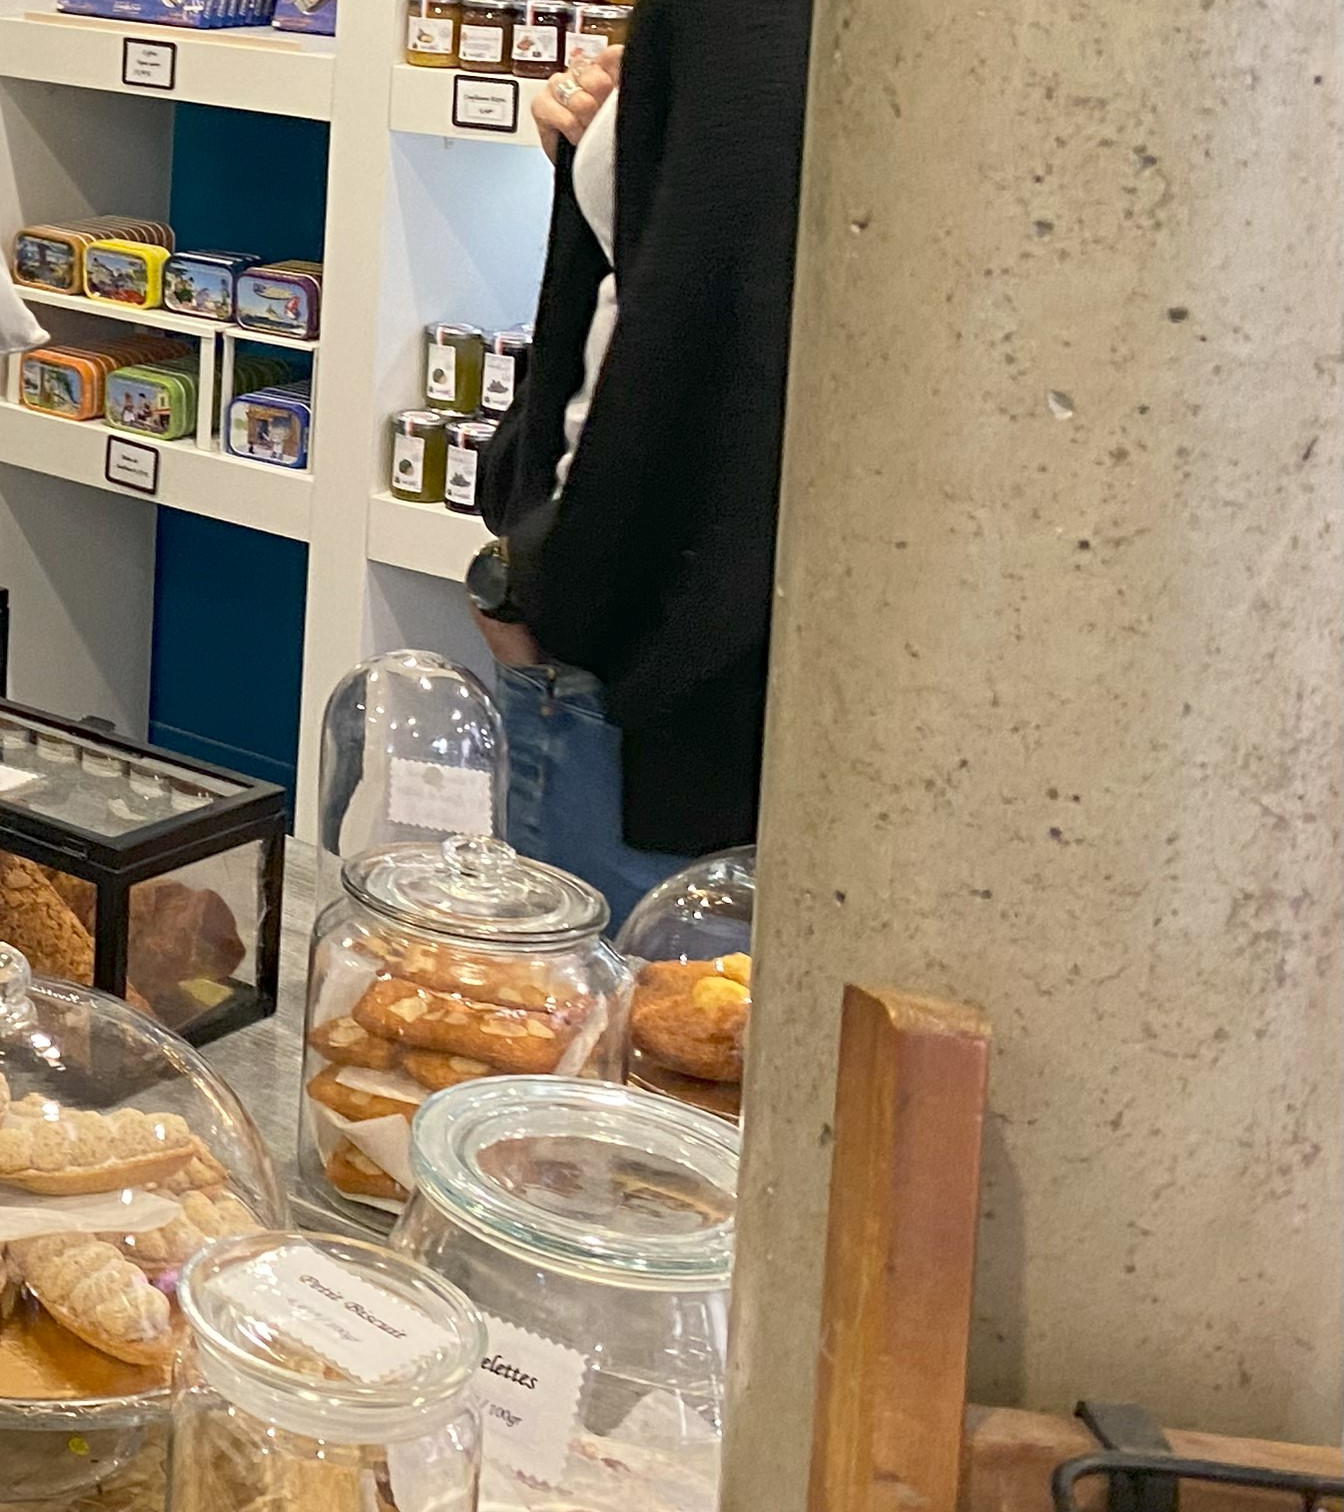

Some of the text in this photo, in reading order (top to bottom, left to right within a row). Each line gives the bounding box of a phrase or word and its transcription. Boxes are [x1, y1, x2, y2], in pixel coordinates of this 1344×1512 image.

[299, 1275, 407, 1339] Petit Biscuit
[480, 1354, 539, 1390] elettes
